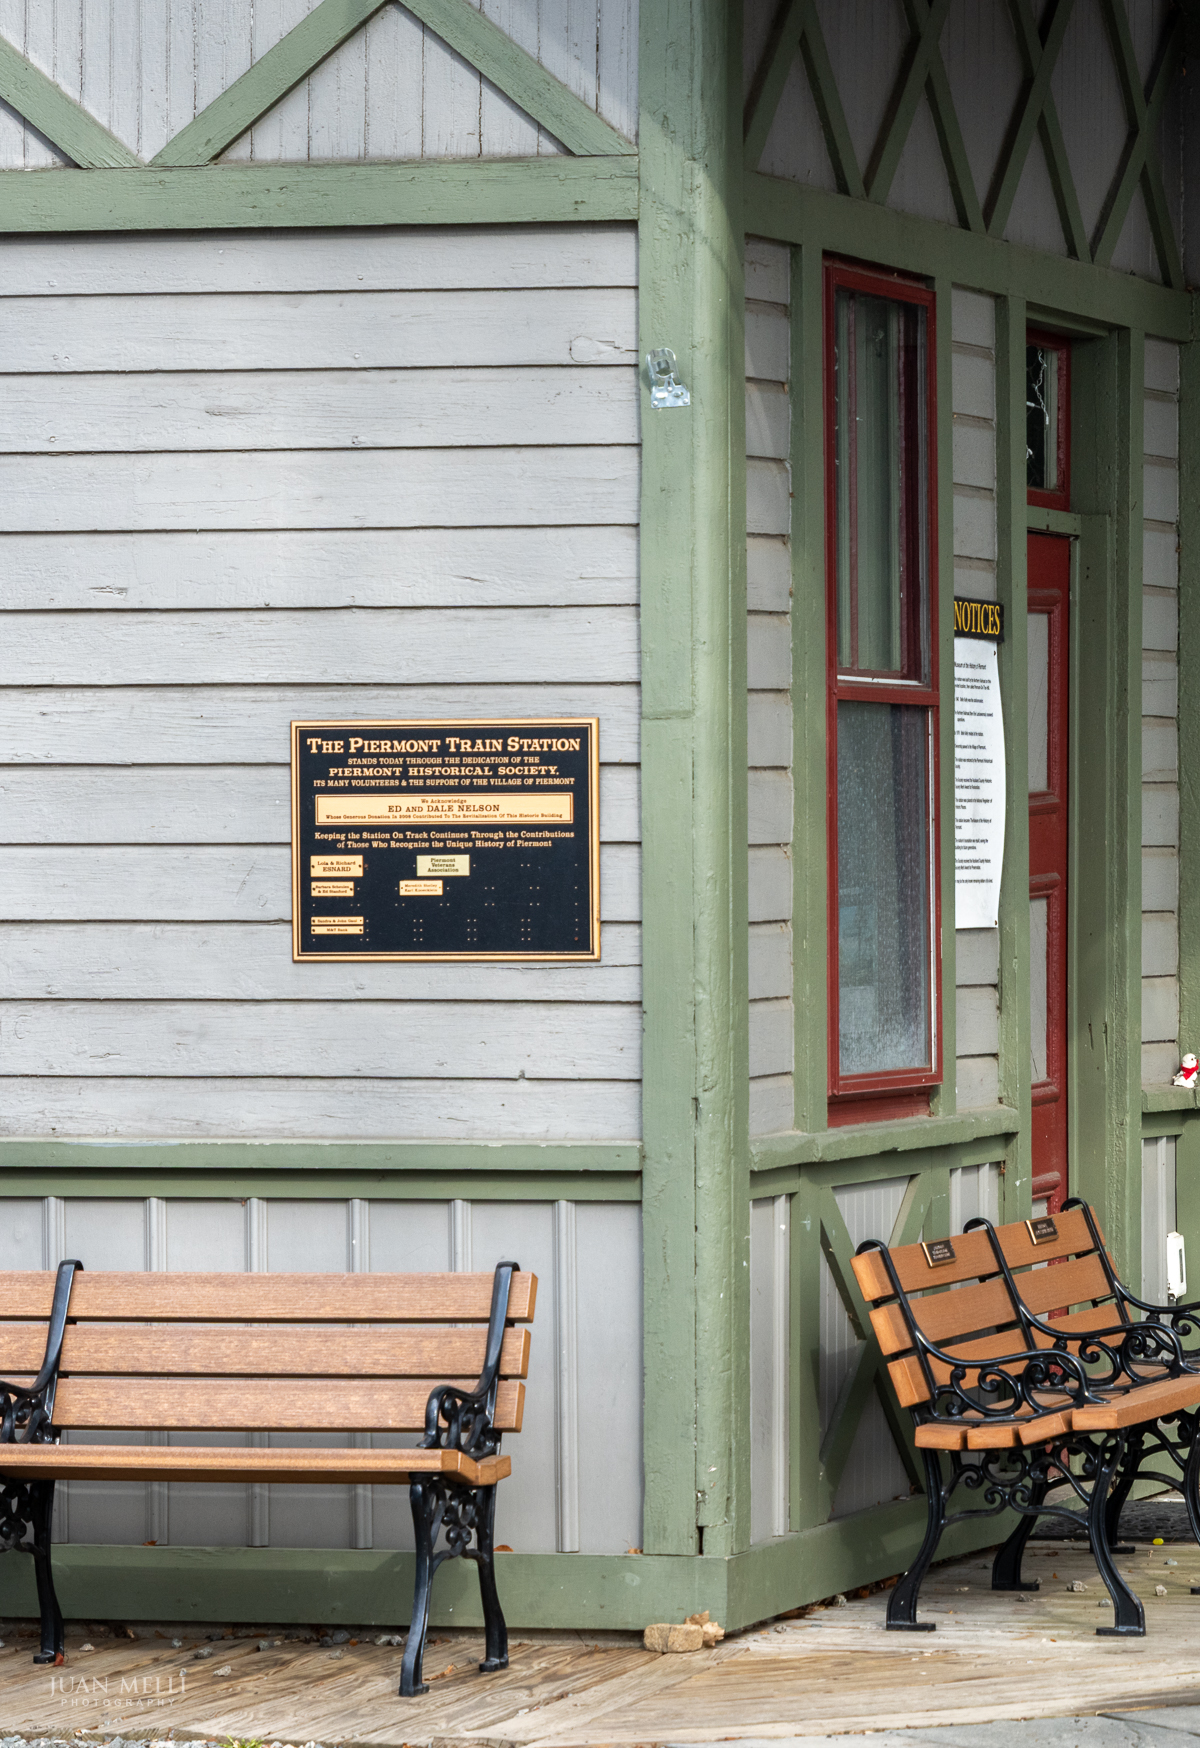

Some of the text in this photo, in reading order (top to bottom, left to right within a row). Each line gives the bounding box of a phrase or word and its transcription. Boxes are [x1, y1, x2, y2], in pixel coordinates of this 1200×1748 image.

[954, 601, 1000, 634] NOTICES
[306, 736, 581, 753] THE PIERMONT TRAIN STATION
[328, 766, 492, 777] PIERMONT HISTORICAL
[313, 777, 575, 787] ITS MANY VOLUNTEERS & THE SUPPORT OF THE VILLAGE OF PIERMONT
[388, 804, 500, 813] ED AND DALE NELSON
[314, 830, 575, 840] Keeping the Station On Track Continues Through the Contributions
[336, 840, 552, 849] of Those Who Recognize the Unique History of Piermont
